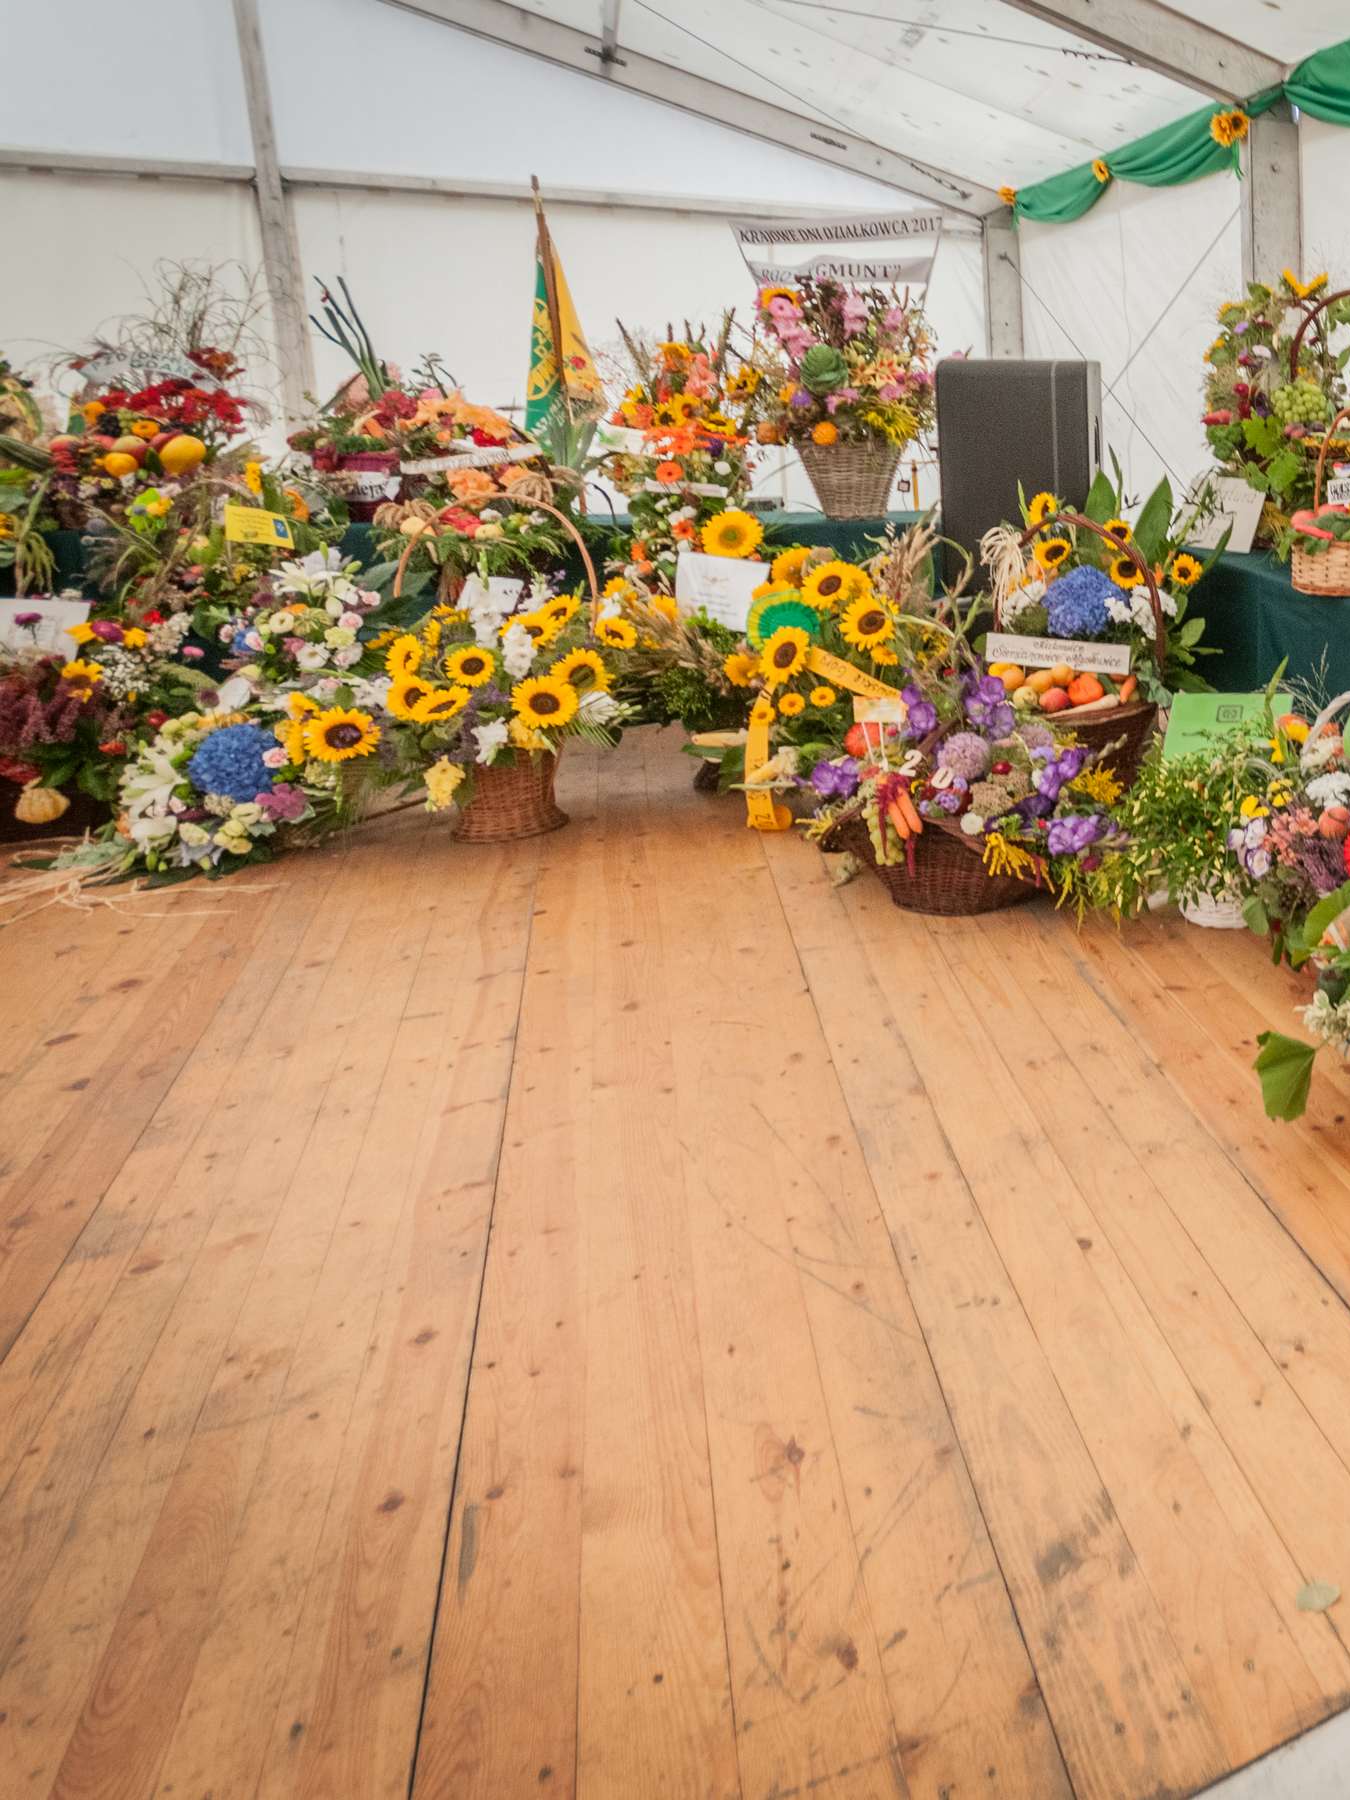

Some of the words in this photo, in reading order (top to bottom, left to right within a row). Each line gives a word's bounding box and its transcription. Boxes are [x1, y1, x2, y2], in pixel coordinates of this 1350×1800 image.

[739, 228, 797, 245] KRAJOWE
[799, 227, 823, 241] DNI
[824, 221, 909, 240] DZIAŁKOWCA
[911, 217, 942, 233] 2017
